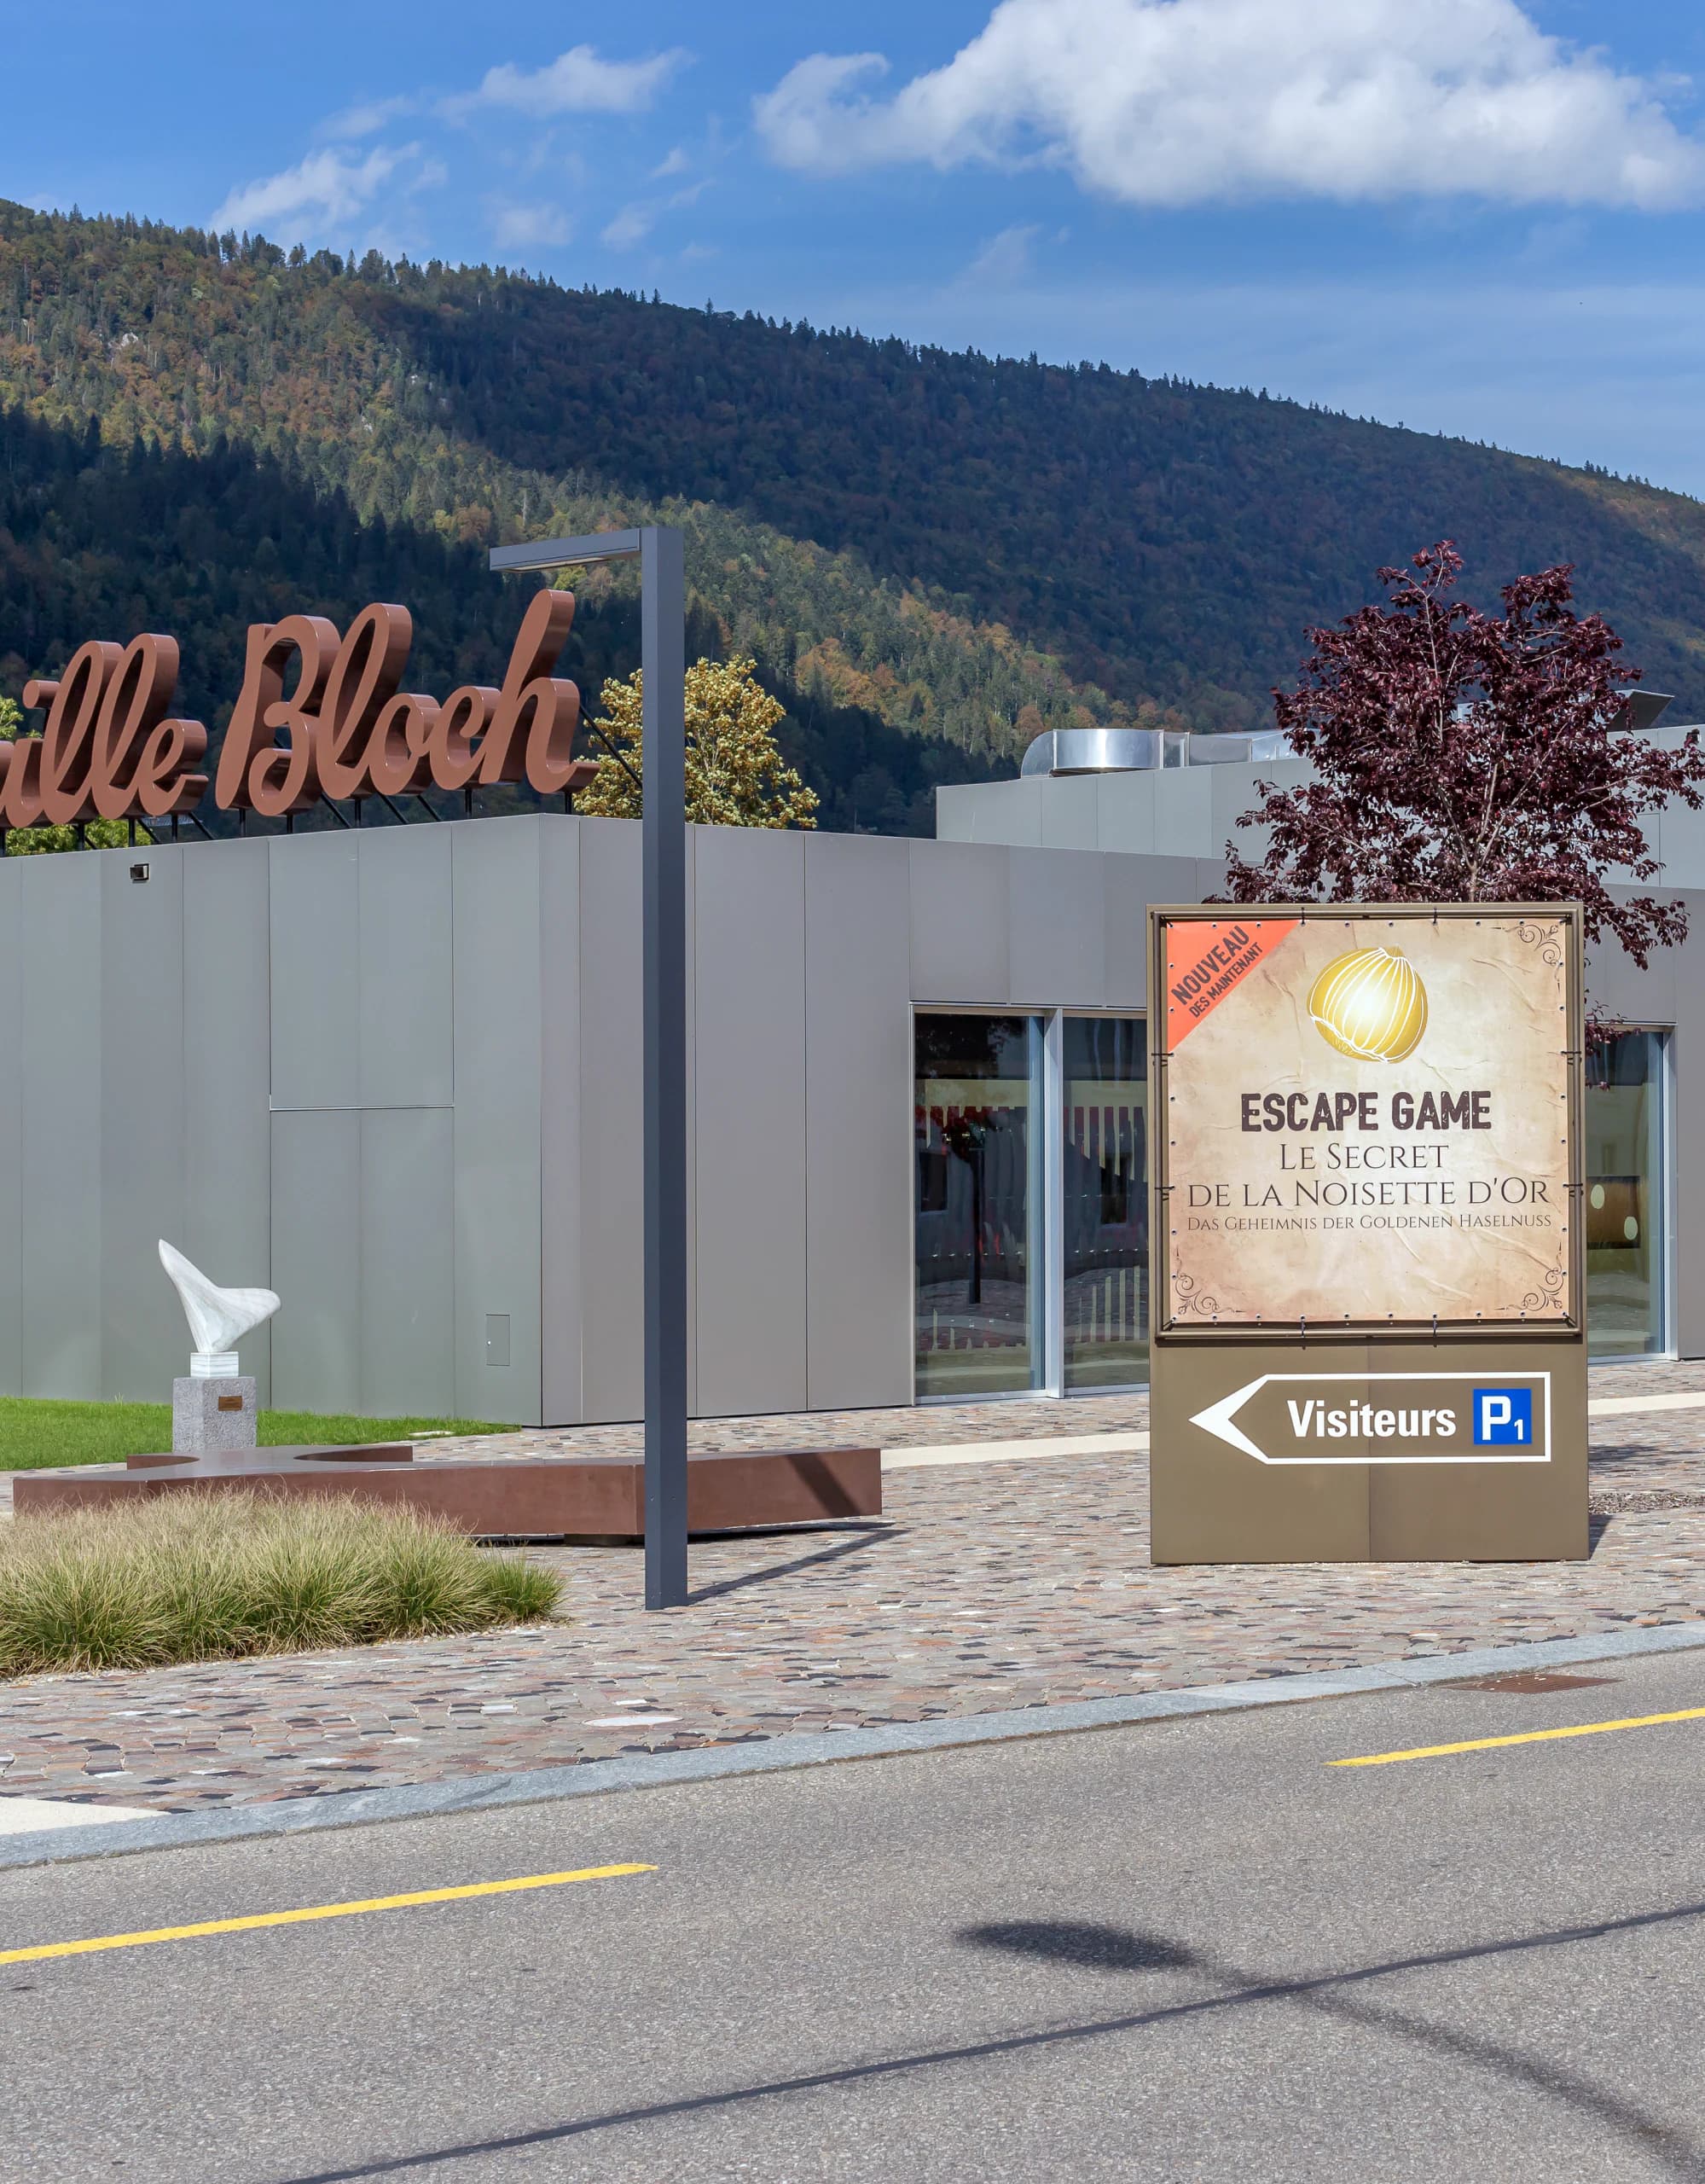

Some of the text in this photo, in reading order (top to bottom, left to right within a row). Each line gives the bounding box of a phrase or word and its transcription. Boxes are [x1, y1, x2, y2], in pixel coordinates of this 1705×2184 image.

[0, 590, 597, 828] ille Bloch
[1170, 925, 1250, 1006] NOUVEAU
[1206, 942, 1263, 1001] MAINTENANT
[1241, 1090, 1492, 1132] ESCAPE GAME
[1327, 1142, 1449, 1170] SECRET
[1294, 1180, 1456, 1206] NOISETTE
[1224, 1216, 1318, 1230] GEHEIMNIS
[1360, 1215, 1453, 1228] GOLDENEN
[1459, 1214, 1551, 1228] HASELNUSS
[1286, 1399, 1457, 1438] Visiteurs
